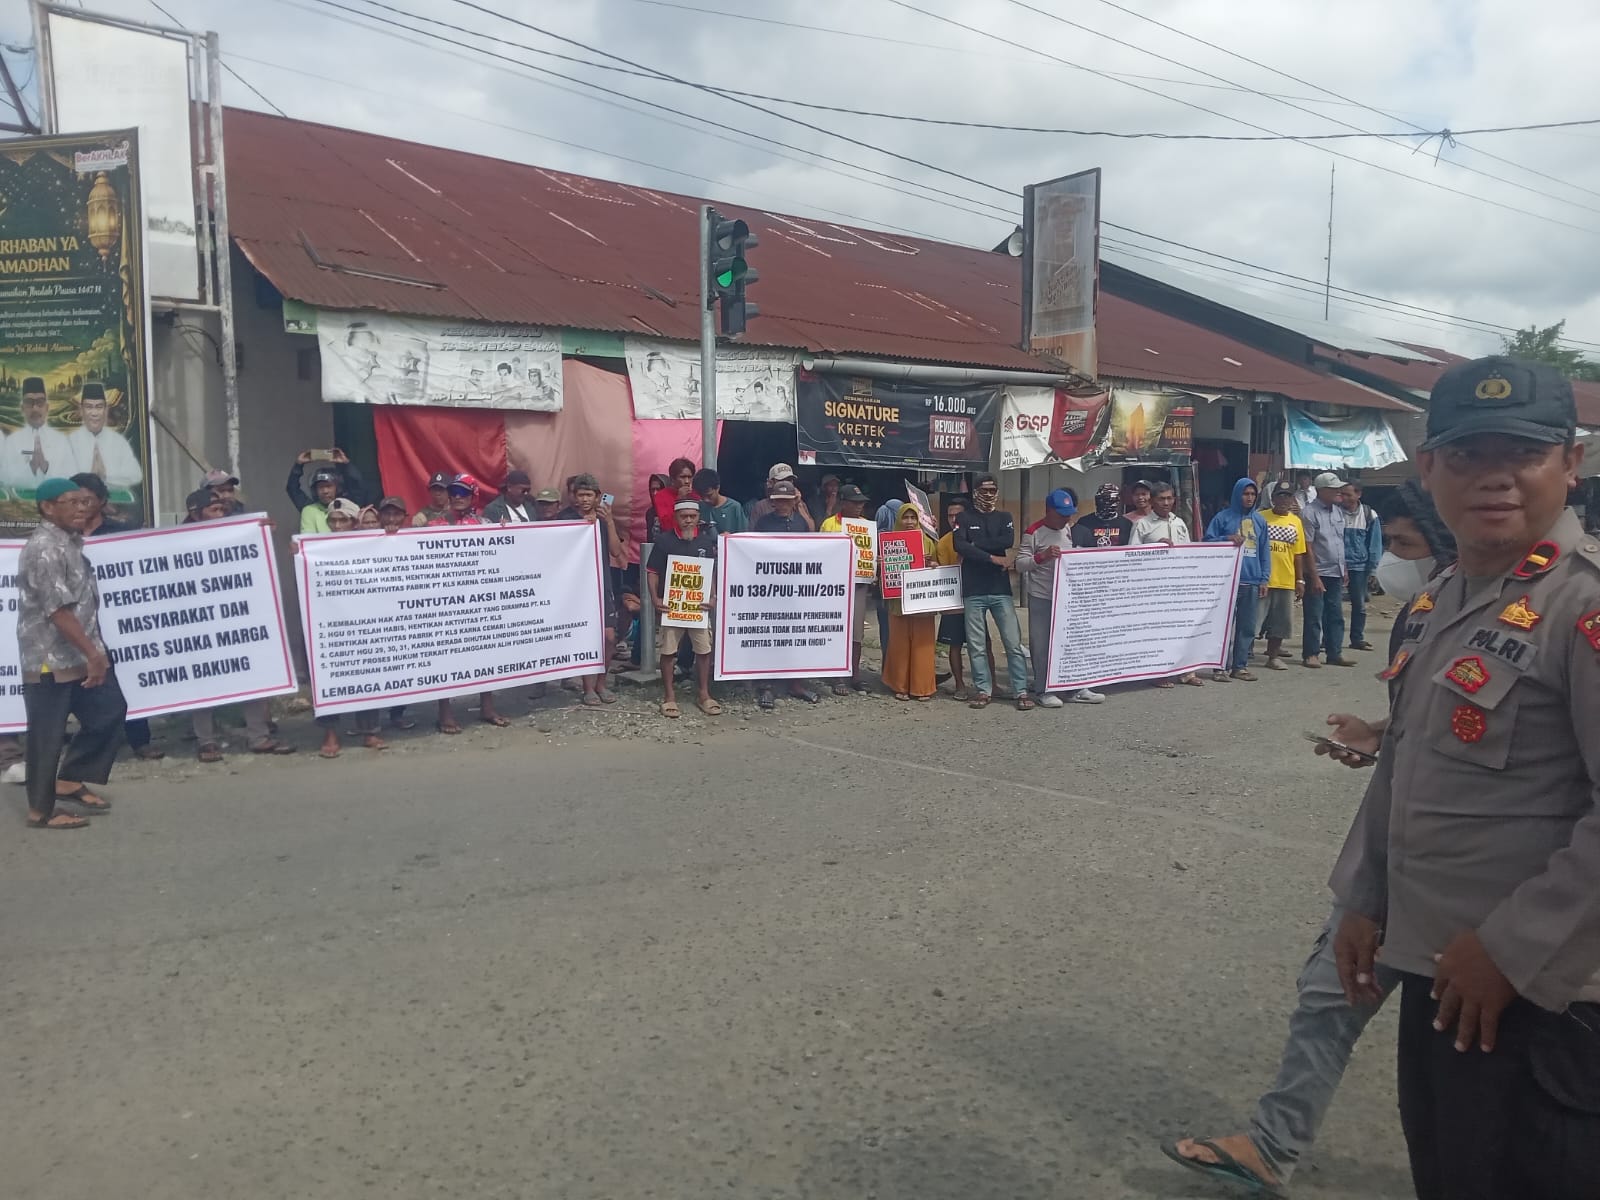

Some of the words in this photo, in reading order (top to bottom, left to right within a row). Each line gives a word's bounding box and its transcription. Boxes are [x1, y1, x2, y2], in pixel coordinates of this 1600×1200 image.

[0, 237, 57, 253] RHABAN
[60, 236, 79, 251] YA
[825, 401, 899, 422] SIGNATURE
[934, 396, 965, 414] 16.000
[838, 422, 885, 438] KRETEK
[934, 419, 966, 435] REVOLUSI
[934, 435, 965, 449] KRETEK
[418, 538, 485, 550] TUNTUTAN
[489, 536, 515, 546] AKSI
[854, 535, 872, 549] GU
[140, 557, 169, 575] IZIN
[174, 552, 203, 570] HGU
[208, 543, 259, 565] DIATAS
[860, 550, 873, 560] KLS
[435, 560, 479, 570] MASYARAKAT
[756, 562, 802, 574] PUTUSAN
[806, 562, 822, 574] MK
[886, 564, 909, 572] HUTAN
[355, 577, 378, 585] TELAH
[406, 573, 440, 581] HENTIKAN
[442, 570, 475, 579] AKTIVITAS
[670, 574, 704, 589] HGU
[103, 579, 197, 608] PERCETAKAN
[202, 572, 253, 594] SAWAH
[326, 588, 365, 597] HENTIKAN
[505, 574, 541, 582] LINGKUNGAN
[730, 585, 743, 597] NO
[747, 584, 845, 597] 138/PUU-XIII/2015
[398, 595, 465, 610] TUNTUTAN
[469, 592, 496, 605] AKSI
[500, 588, 536, 601] MASSA
[686, 590, 704, 601] KLS
[910, 592, 925, 600] TANPA
[118, 605, 215, 634] MASYARAKAT
[221, 600, 249, 617] DAN
[761, 612, 801, 620] PERUSAHAAN
[803, 612, 842, 620] PERKEBUNAN
[737, 626, 770, 634] INDONESIA
[792, 625, 805, 633] BISA
[110, 642, 160, 664] DIATAS
[164, 635, 212, 656] SUAKA
[217, 625, 269, 648] MARGA
[329, 650, 354, 658] CABUT
[400, 643, 410, 651] 31,
[411, 641, 435, 649] KARNA
[437, 638, 462, 648] BERADA
[464, 635, 491, 643] DIHUTAN
[493, 631, 519, 639] LINDUNG
[533, 626, 552, 634] SAWAH
[554, 621, 588, 631] MASYARAKAT
[741, 640, 771, 648] AKTIFITAS
[774, 639, 792, 647] TANPA
[330, 659, 360, 668] TUNTUT
[363, 657, 391, 665] PROSES
[393, 653, 418, 662] HUKUM
[420, 650, 448, 658] TERKAIT
[450, 643, 496, 654] PELANGGARAN
[513, 638, 533, 646] FUNGSI
[138, 666, 188, 688] SATWA
[193, 656, 250, 678] BAKUNG
[322, 683, 381, 698] LEMBAGA
[384, 678, 414, 691] ADAT
[417, 674, 447, 686] SUKU
[451, 671, 471, 681] TAA
[474, 667, 494, 678] DAN
[497, 660, 537, 674] SERIKAT
[540, 654, 570, 667] PETANI
[573, 651, 598, 661] TOILI
[330, 667, 380, 678] PERKEBUNAN
[10, 685, 24, 695] DE
